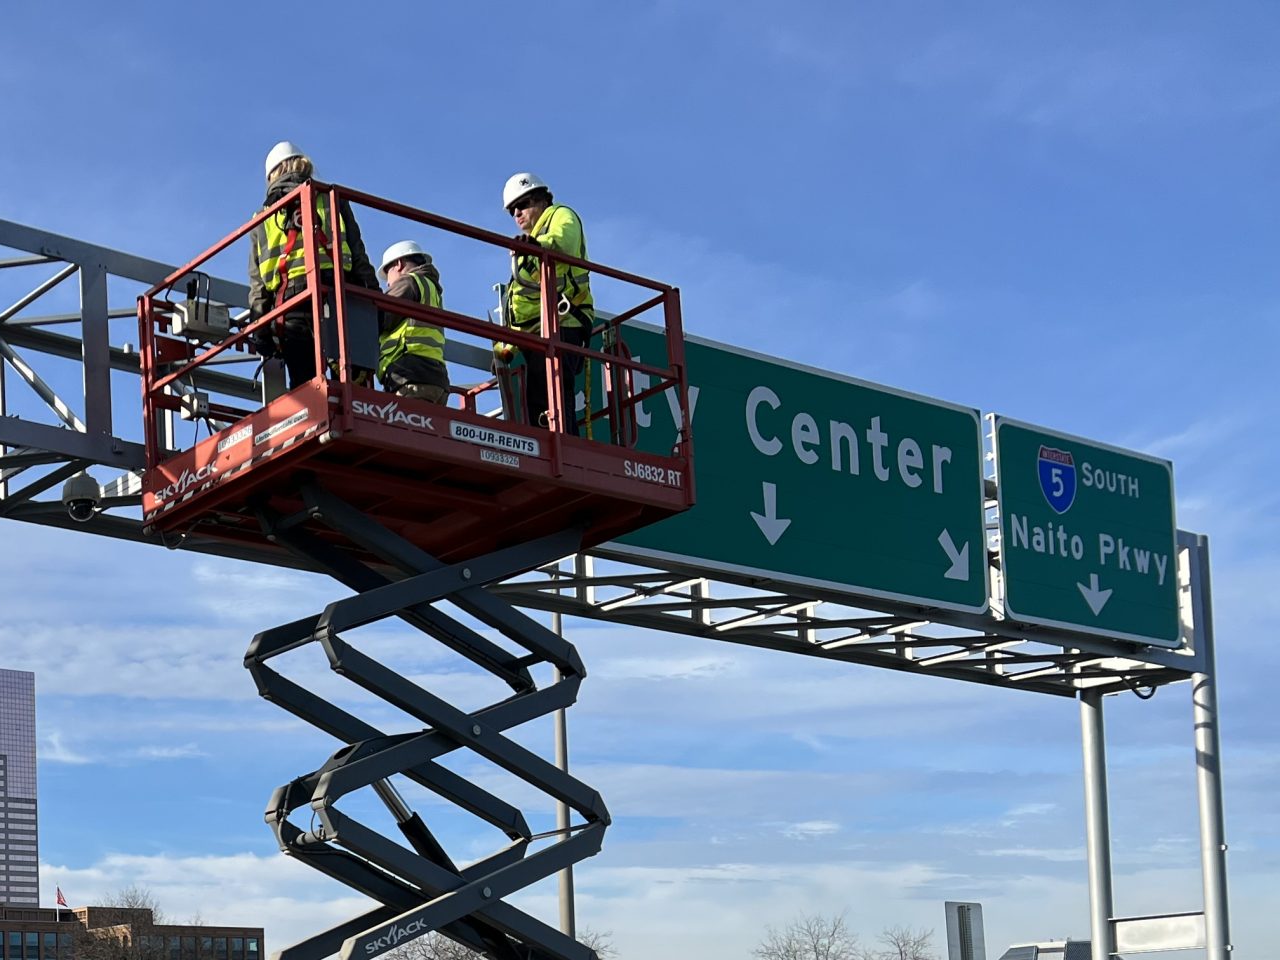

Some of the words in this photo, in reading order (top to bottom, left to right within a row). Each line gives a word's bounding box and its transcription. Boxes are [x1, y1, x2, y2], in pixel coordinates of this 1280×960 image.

[352, 400, 435, 431] SKYJACK
[455, 425, 535, 452] 800-UR-RENTS
[745, 385, 953, 494] Center
[623, 460, 666, 484] SJ6832
[667, 469, 682, 486] RT
[1042, 450, 1071, 465] INTERSTATE
[154, 460, 219, 504] SKYJACK
[1051, 468, 1064, 498] 5
[1081, 462, 1140, 499] SOUTH
[1011, 513, 1084, 561] Naito
[1098, 533, 1168, 586] Pkwy
[365, 917, 428, 954] SKYJACK
